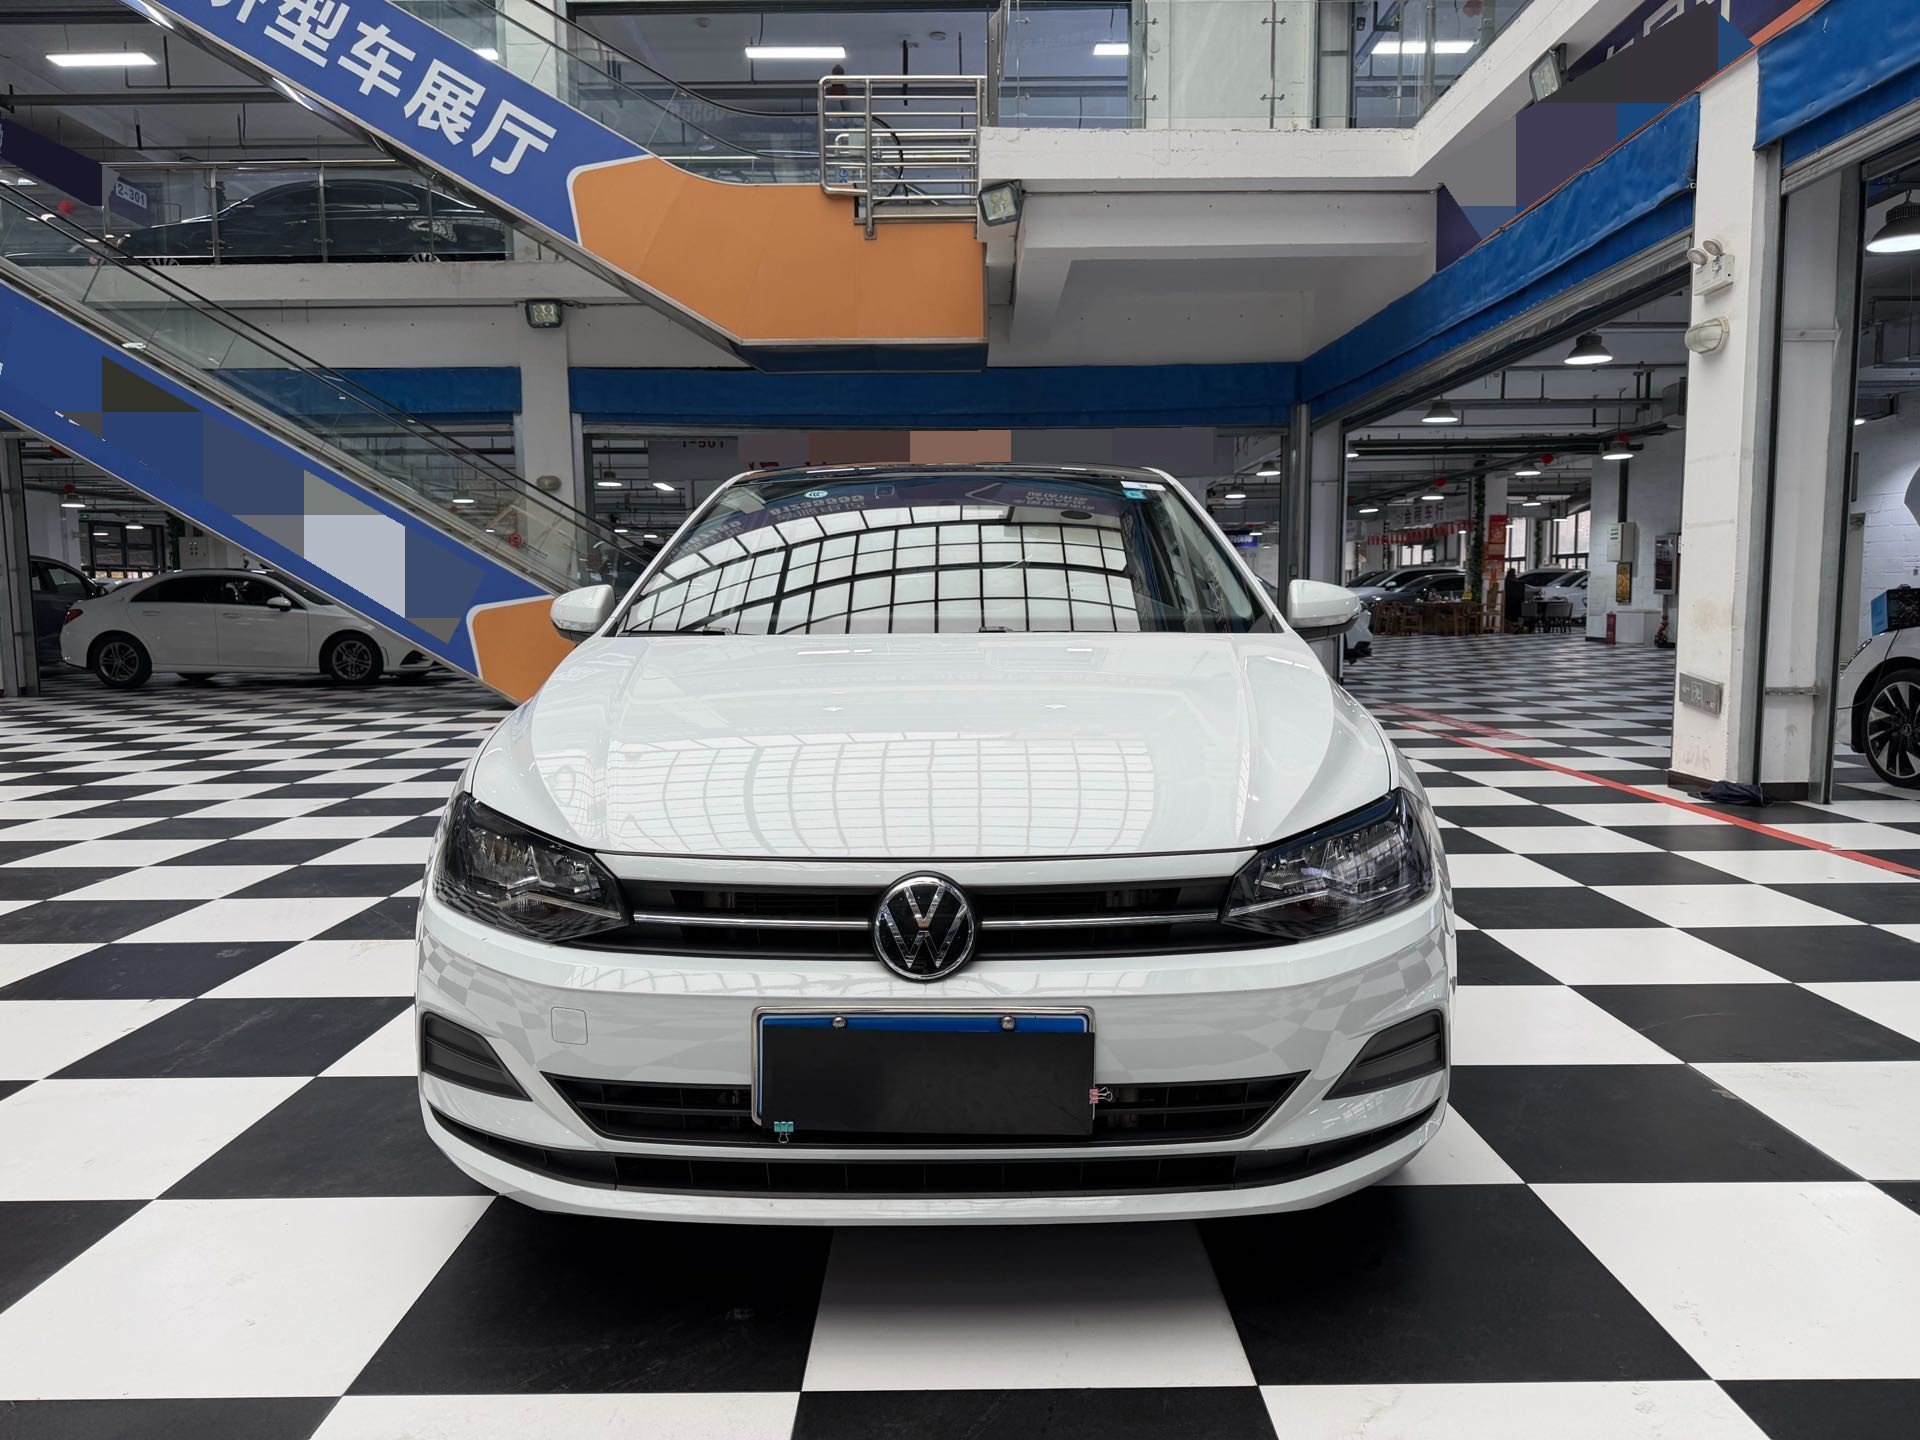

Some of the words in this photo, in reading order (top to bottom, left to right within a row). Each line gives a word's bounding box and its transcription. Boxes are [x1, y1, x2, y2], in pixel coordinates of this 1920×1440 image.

[211, 0, 557, 175] 型车展厅
[117, 183, 145, 206] 2-301
